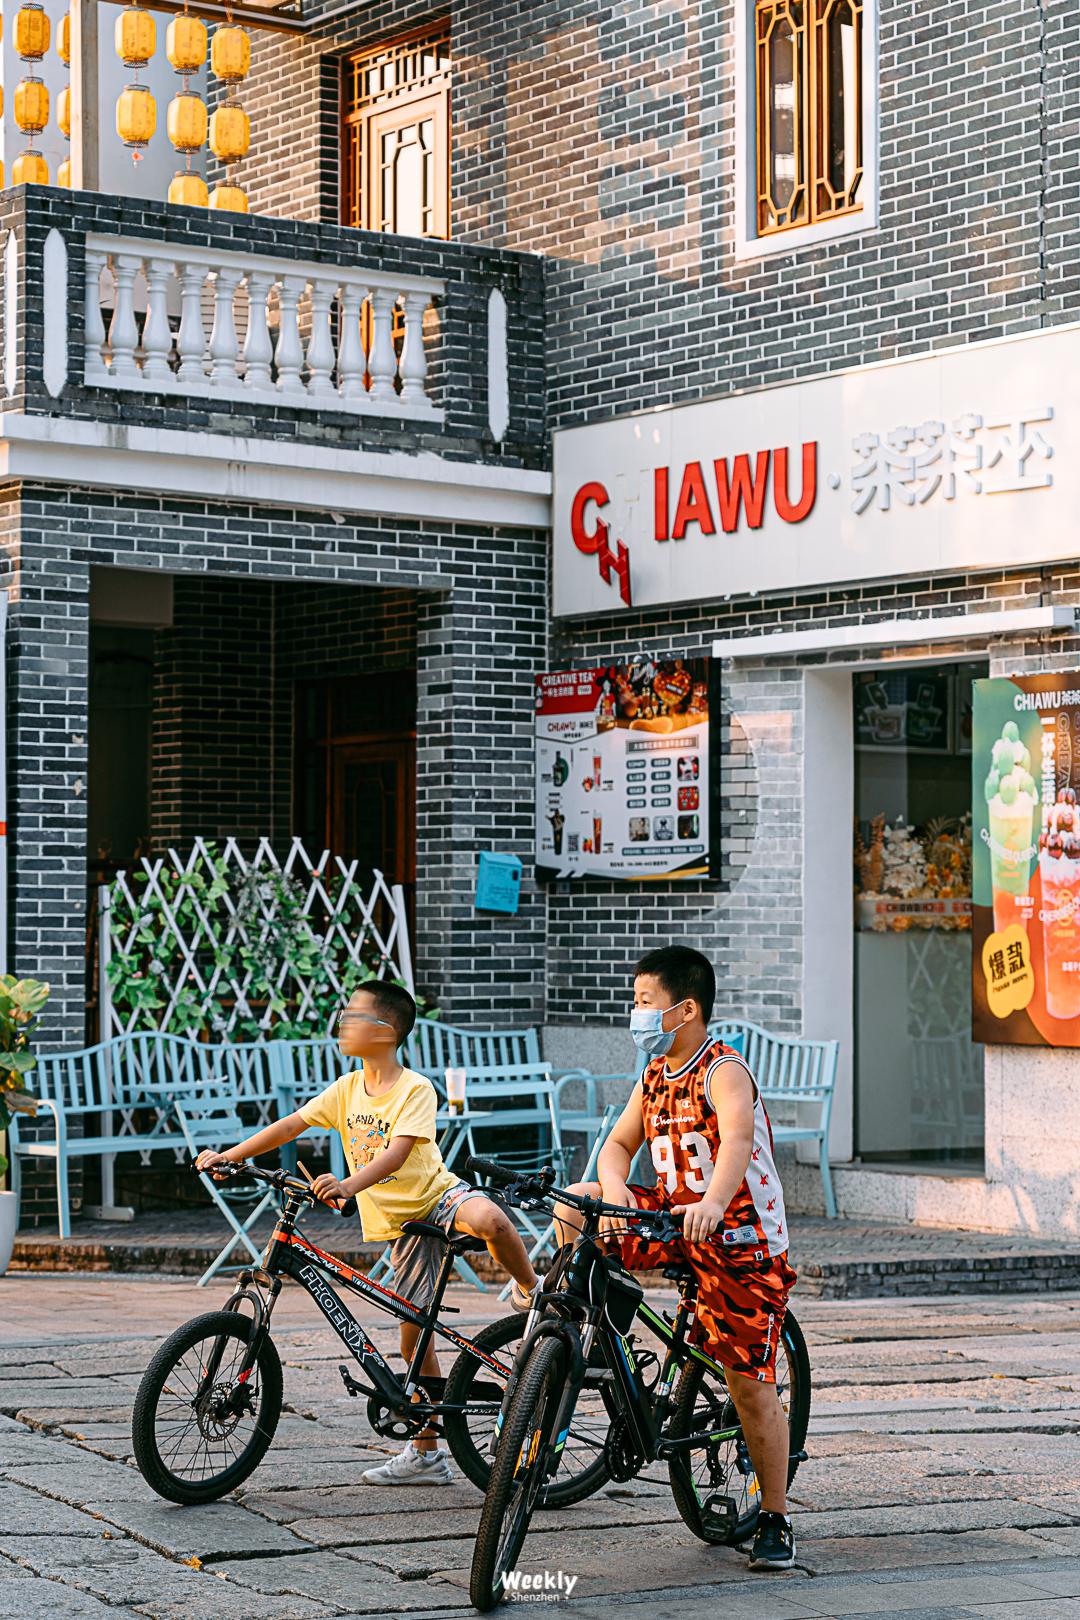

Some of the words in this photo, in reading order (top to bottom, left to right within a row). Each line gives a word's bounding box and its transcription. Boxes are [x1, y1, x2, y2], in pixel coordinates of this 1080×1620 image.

[1014, 693, 1061, 711] CHIAWU
[988, 941, 1025, 982] 爆款
[650, 1131, 715, 1197] 93
[292, 1243, 342, 1274] PHOENIX
[299, 1265, 368, 1364] PHOENIX
